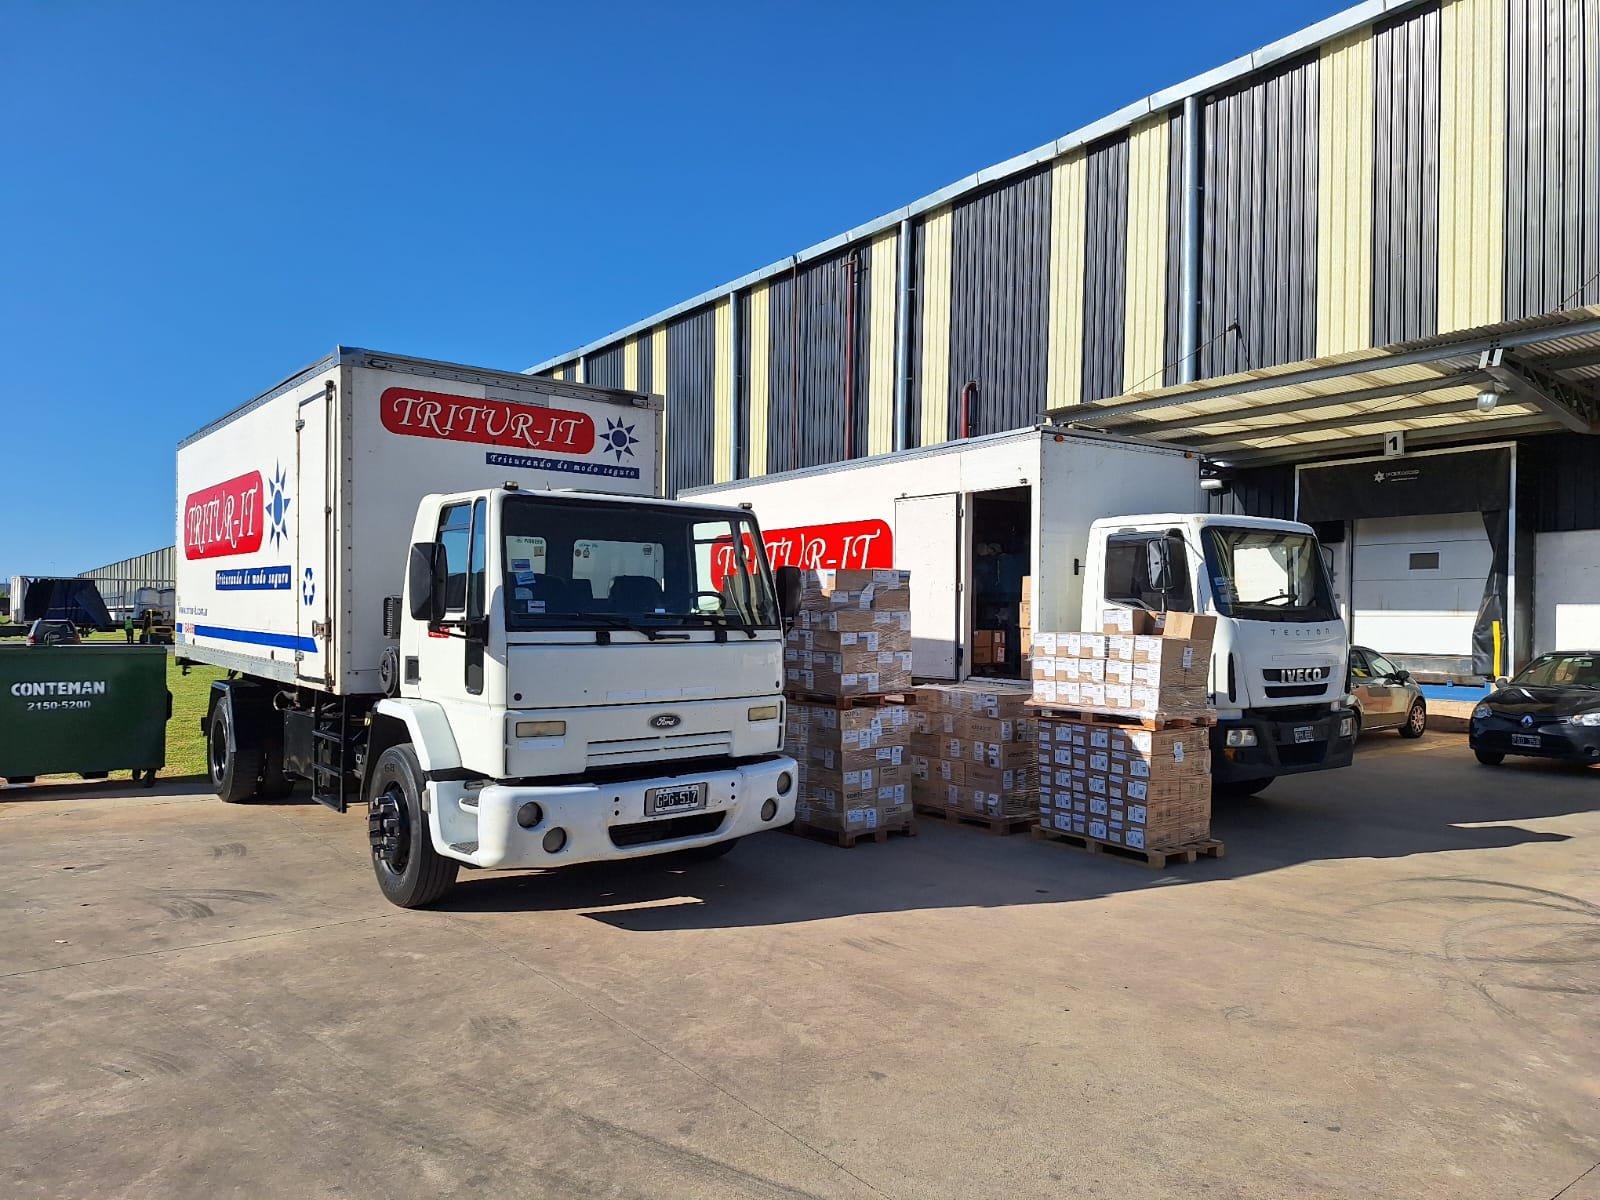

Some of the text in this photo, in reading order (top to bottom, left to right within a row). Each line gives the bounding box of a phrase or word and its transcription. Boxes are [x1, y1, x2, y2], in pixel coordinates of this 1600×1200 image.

[393, 397, 584, 447] TRITUR-IT
[1389, 436, 1398, 451] 1
[490, 454, 635, 478] Triturando de modo seguro
[187, 481, 259, 554] TRITUR-IT
[1280, 668, 1322, 683] IVECO
[11, 681, 105, 696] CONTEMAN
[27, 700, 91, 711] 2150-5200
[656, 716, 675, 726] Ford
[680, 790, 697, 804] 517
